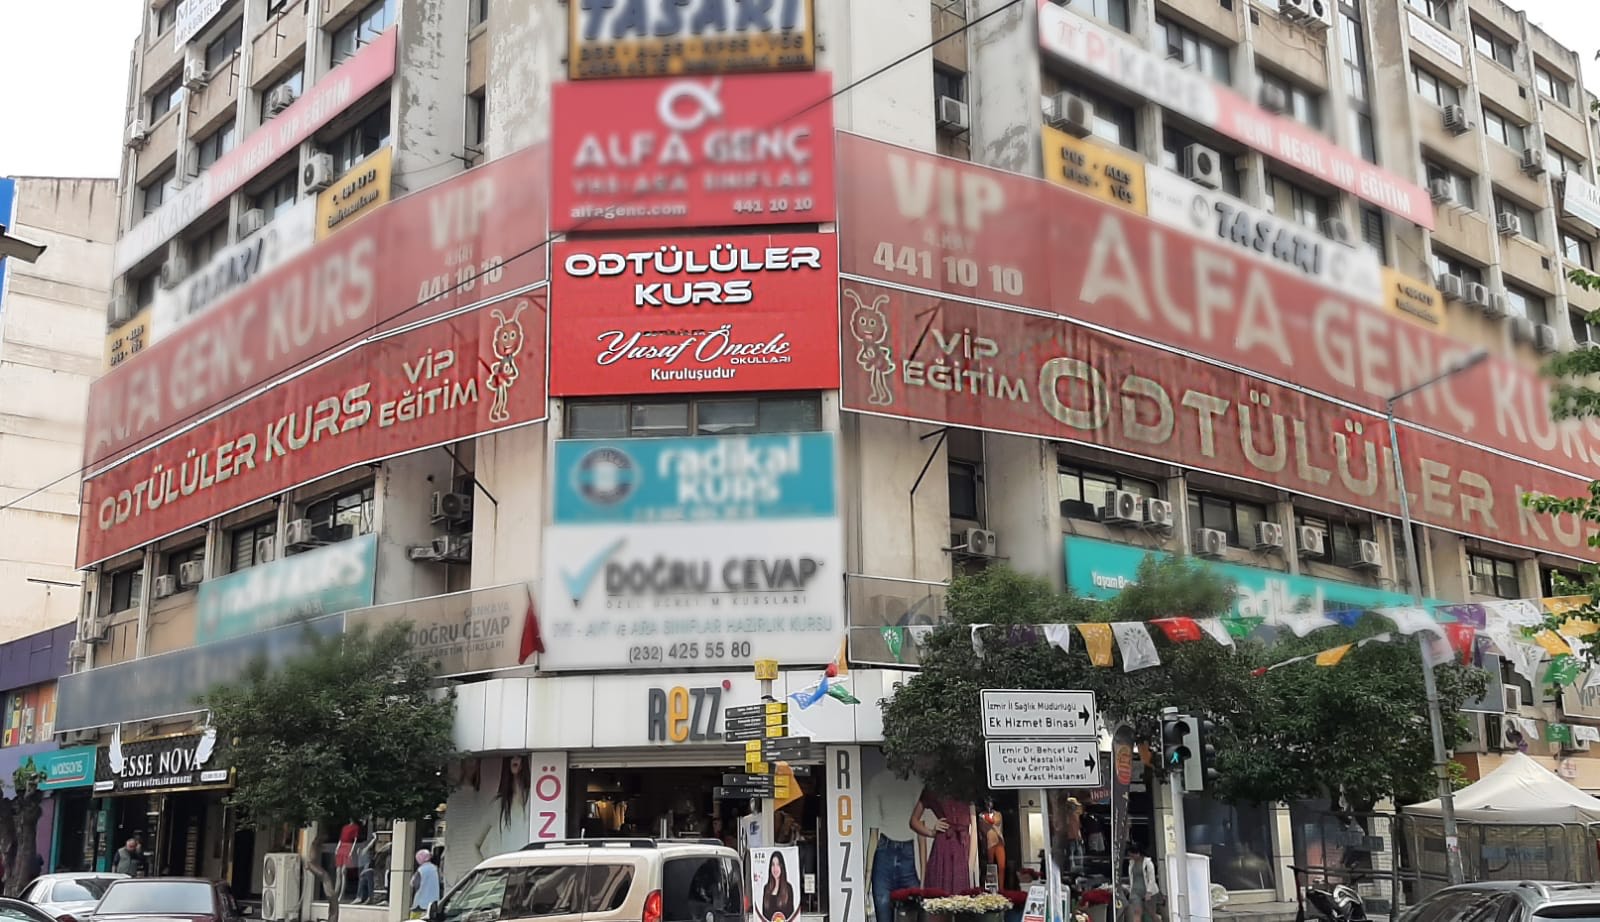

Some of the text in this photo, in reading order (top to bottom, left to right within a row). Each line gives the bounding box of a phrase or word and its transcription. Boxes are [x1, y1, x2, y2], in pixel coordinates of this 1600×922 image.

[573, 126, 812, 167] ALFA GENÇ
[570, 197, 813, 219] alfagenc.com 441 10 10
[564, 243, 822, 277] ODTÜLÜLER
[873, 241, 1024, 296] 441 10 10
[417, 273, 449, 306] 441
[454, 264, 476, 296] 10
[480, 255, 503, 286] 10
[634, 279, 754, 307] KURS
[1079, 212, 1294, 367] ALFA
[596, 324, 791, 366] Yusuf Öncebe
[651, 366, 737, 381] Kuruluşudur
[903, 358, 1030, 403] EĞİTİM
[378, 378, 480, 428] EĞİTİM
[99, 382, 372, 531] ODTÜLÜLER KURS
[658, 434, 802, 478] radikal
[1038, 357, 1499, 530] ODTÜLÜLER
[679, 474, 783, 503] KURS
[606, 556, 817, 594] DOĞRU CEVAP
[629, 640, 751, 662] (232) 425 55 80
[989, 717, 1077, 728] Ek Hizmet Binası
[120, 747, 203, 778] ESSE NOVA
[1028, 764, 1065, 772] Cerrahisi
